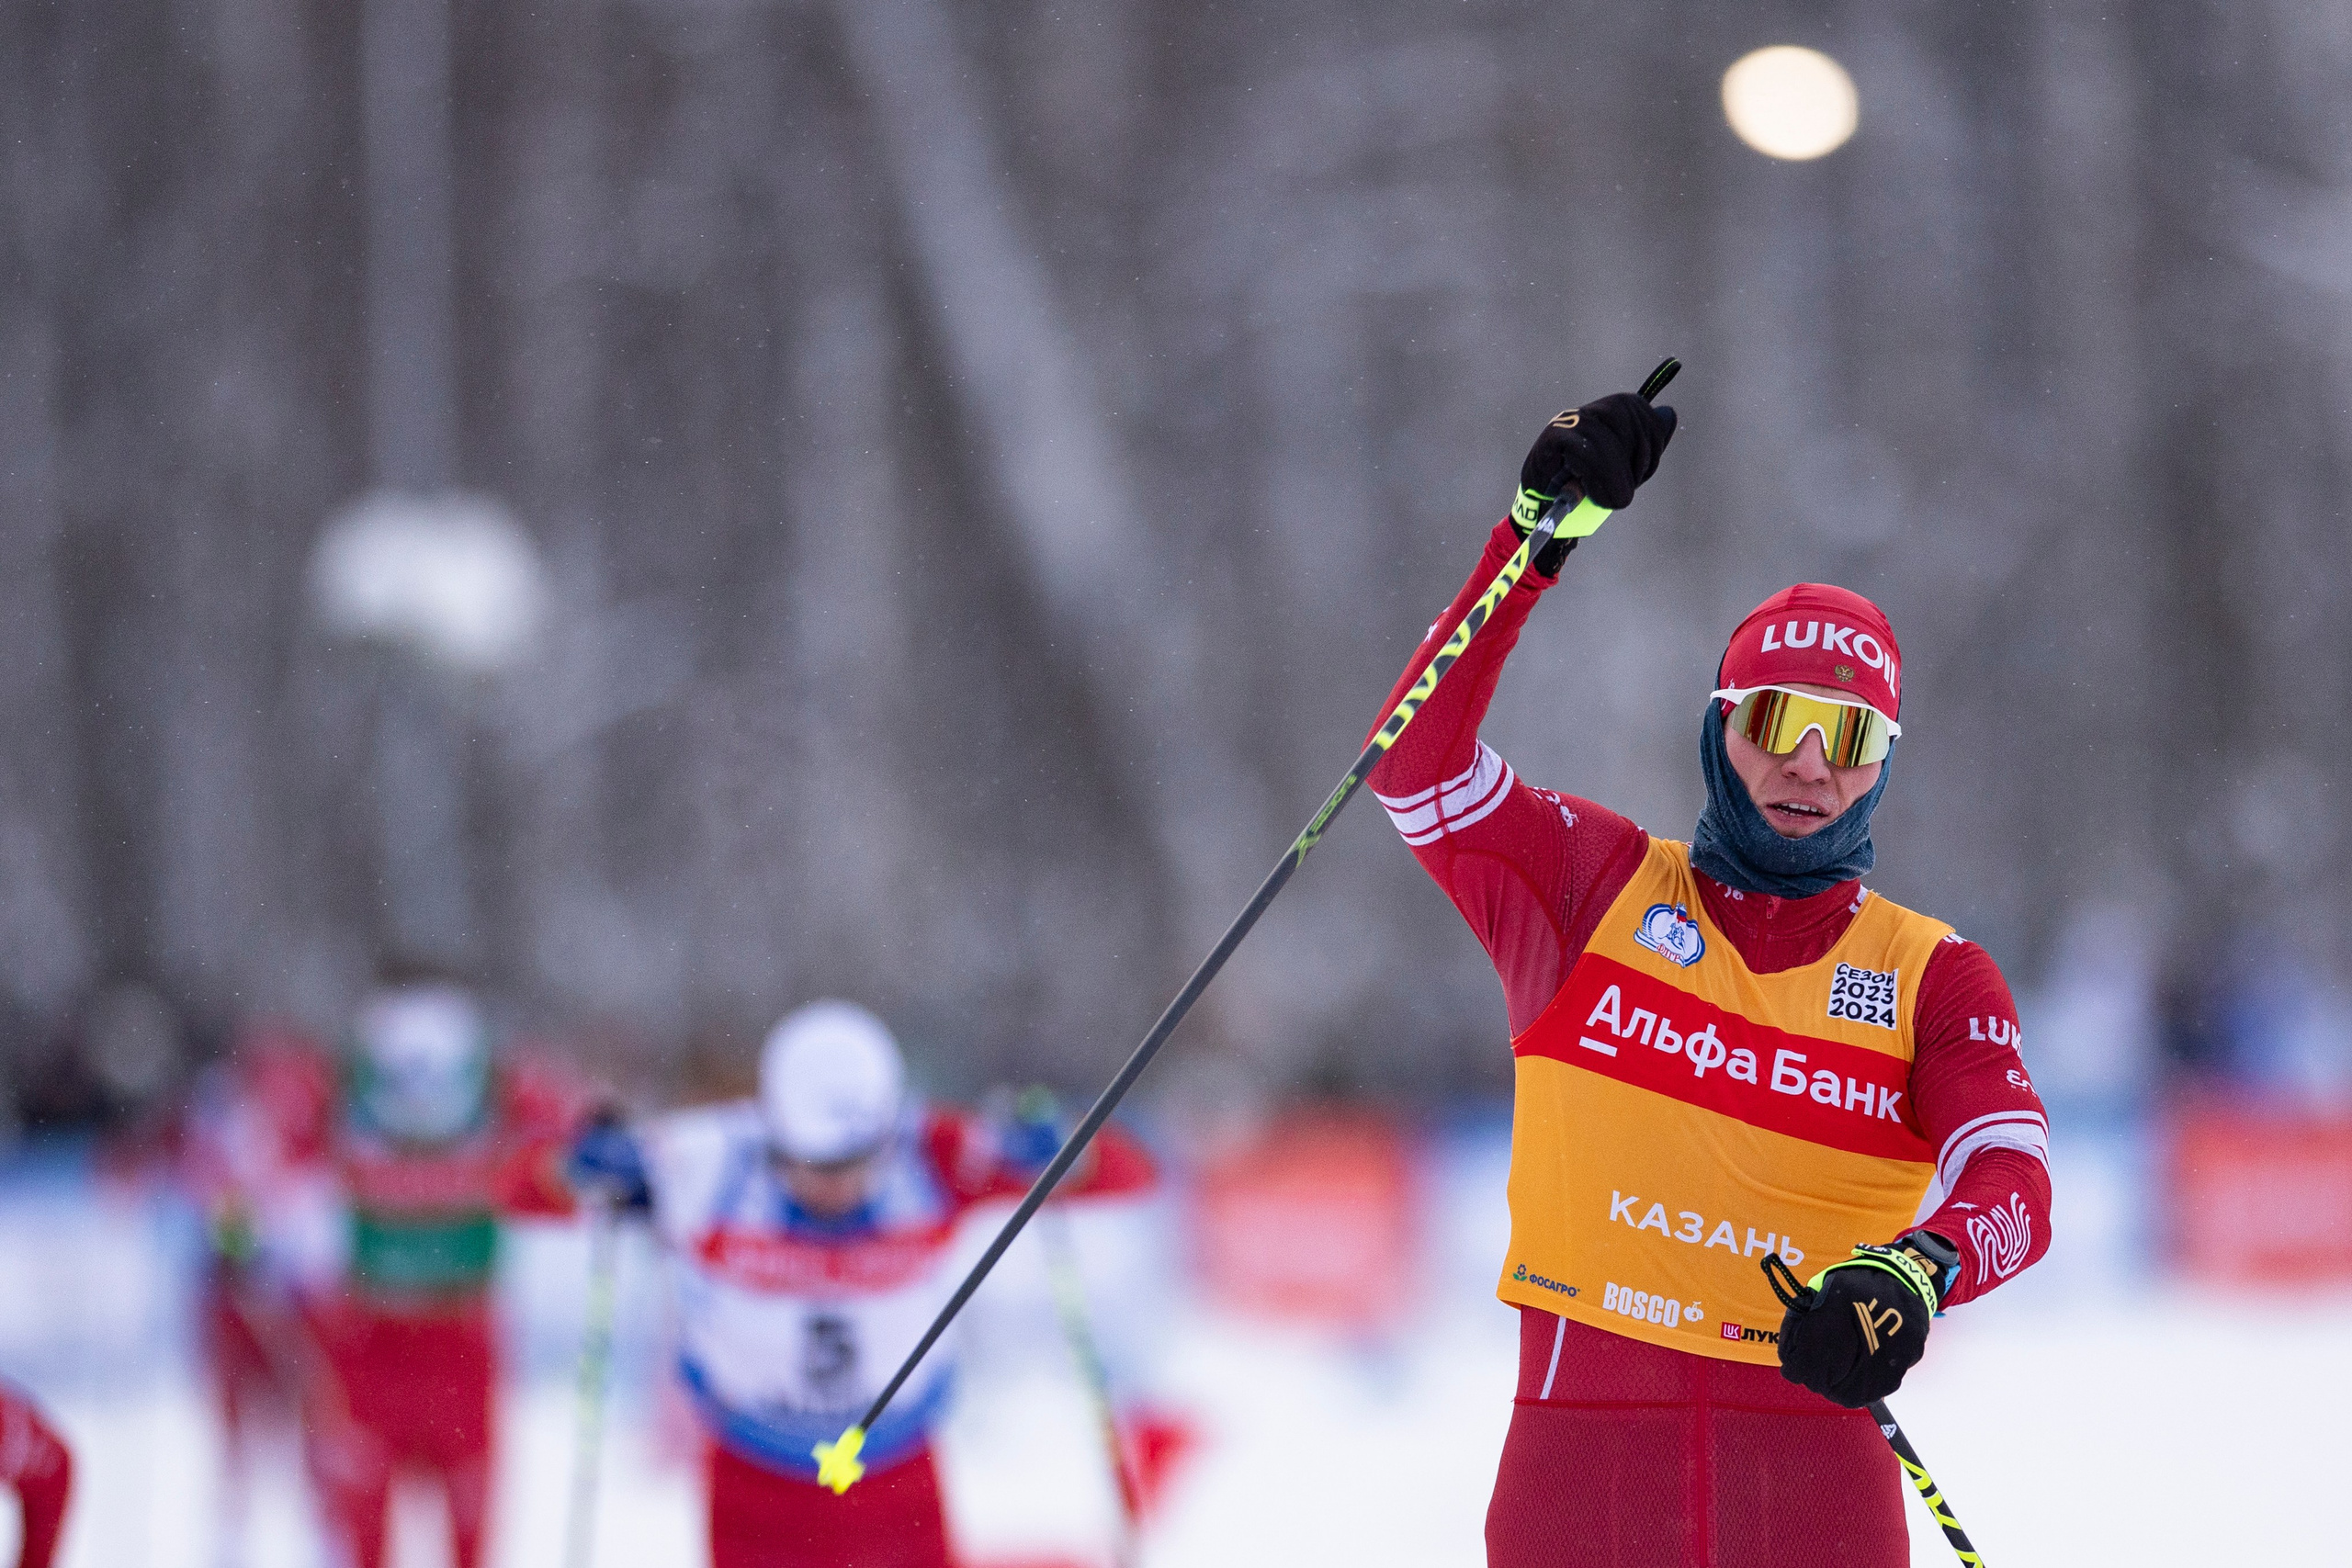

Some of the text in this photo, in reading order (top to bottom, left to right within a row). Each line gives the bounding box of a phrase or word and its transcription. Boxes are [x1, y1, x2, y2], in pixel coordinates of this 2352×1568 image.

[1760, 620, 1896, 699] LUKOIL
[1832, 976, 1894, 1005] 2023
[1836, 963, 1895, 987] СЕЗОН
[1828, 997, 1895, 1028] 2024
[1584, 984, 1904, 1124] Альфа Банк
[1969, 1015, 2022, 1059] LUK
[1609, 1190, 1805, 1268] КАЗАНЬ
[1529, 1273, 1577, 1298] ФОСАГРО
[1601, 1280, 1680, 1328] BOSCO
